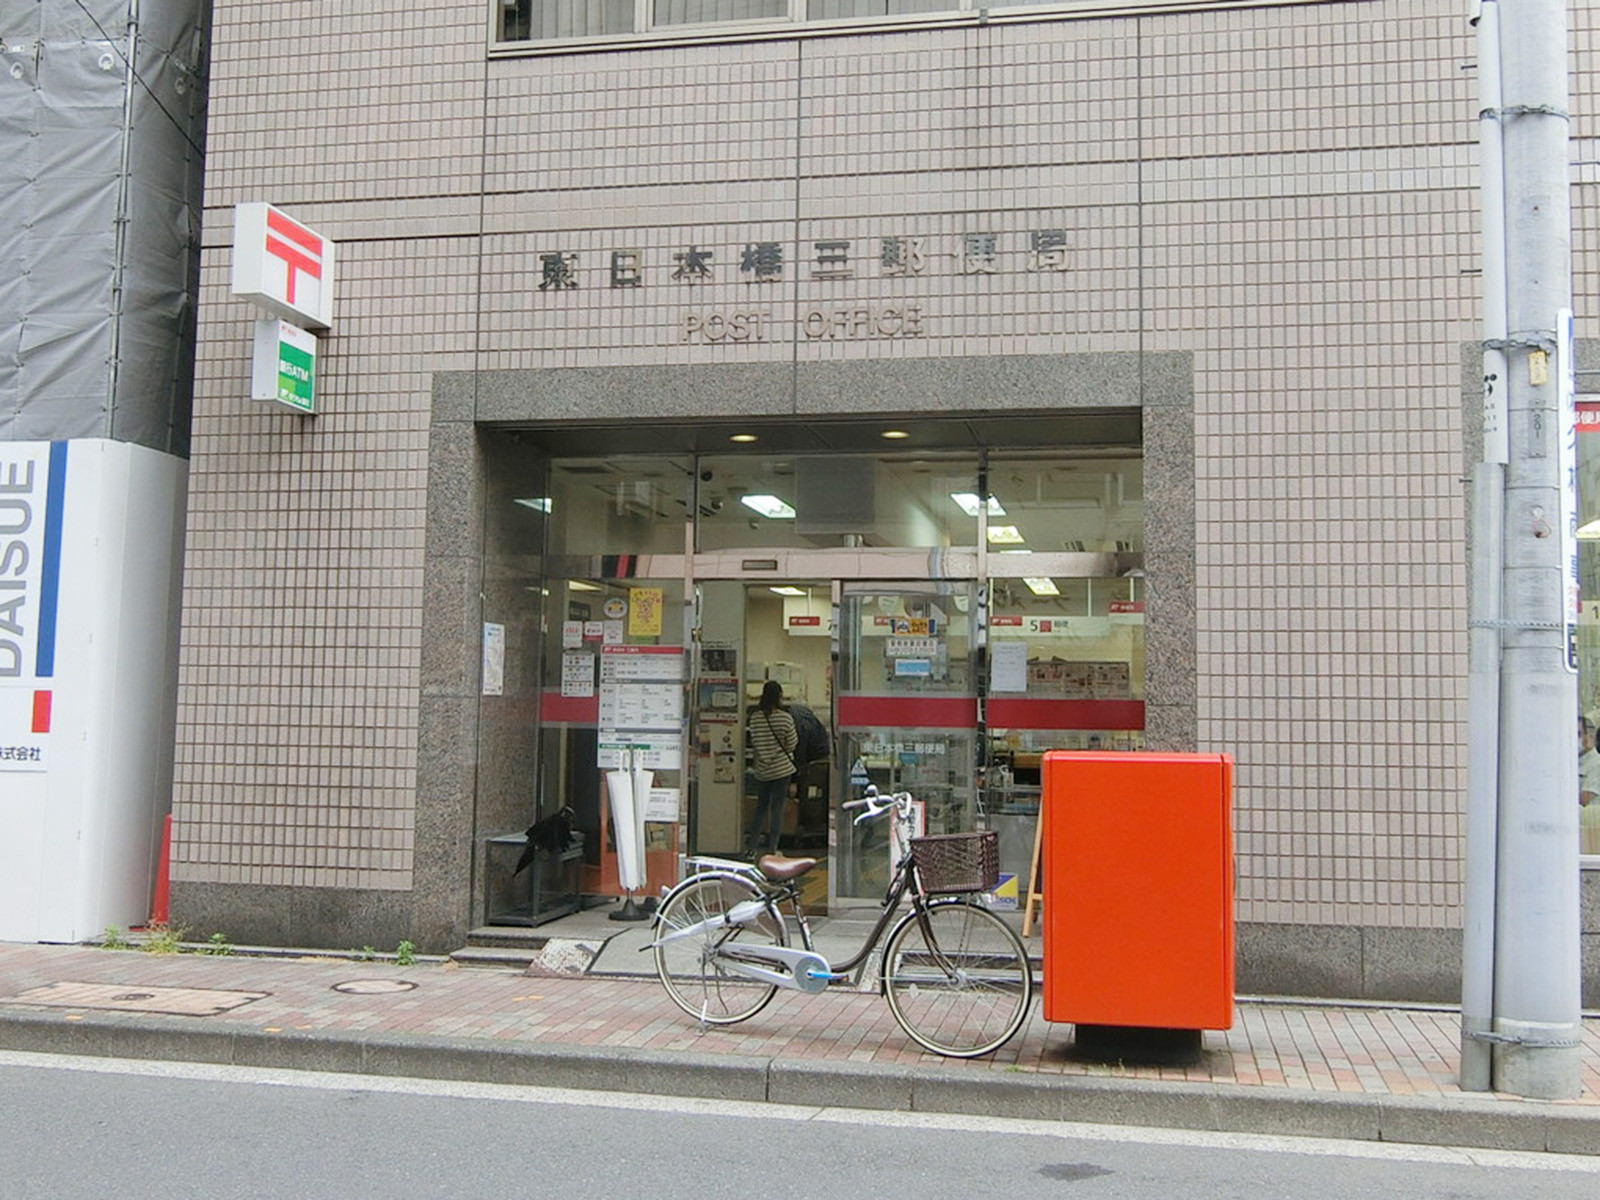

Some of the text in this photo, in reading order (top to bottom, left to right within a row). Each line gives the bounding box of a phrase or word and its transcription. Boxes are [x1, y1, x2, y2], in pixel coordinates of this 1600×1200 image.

[538, 229, 1072, 291] 東日本橋三郵便局
[682, 302, 923, 342] POST OFFICE
[0, 460, 35, 677] DAISUE
[0, 746, 41, 761] 式会社
